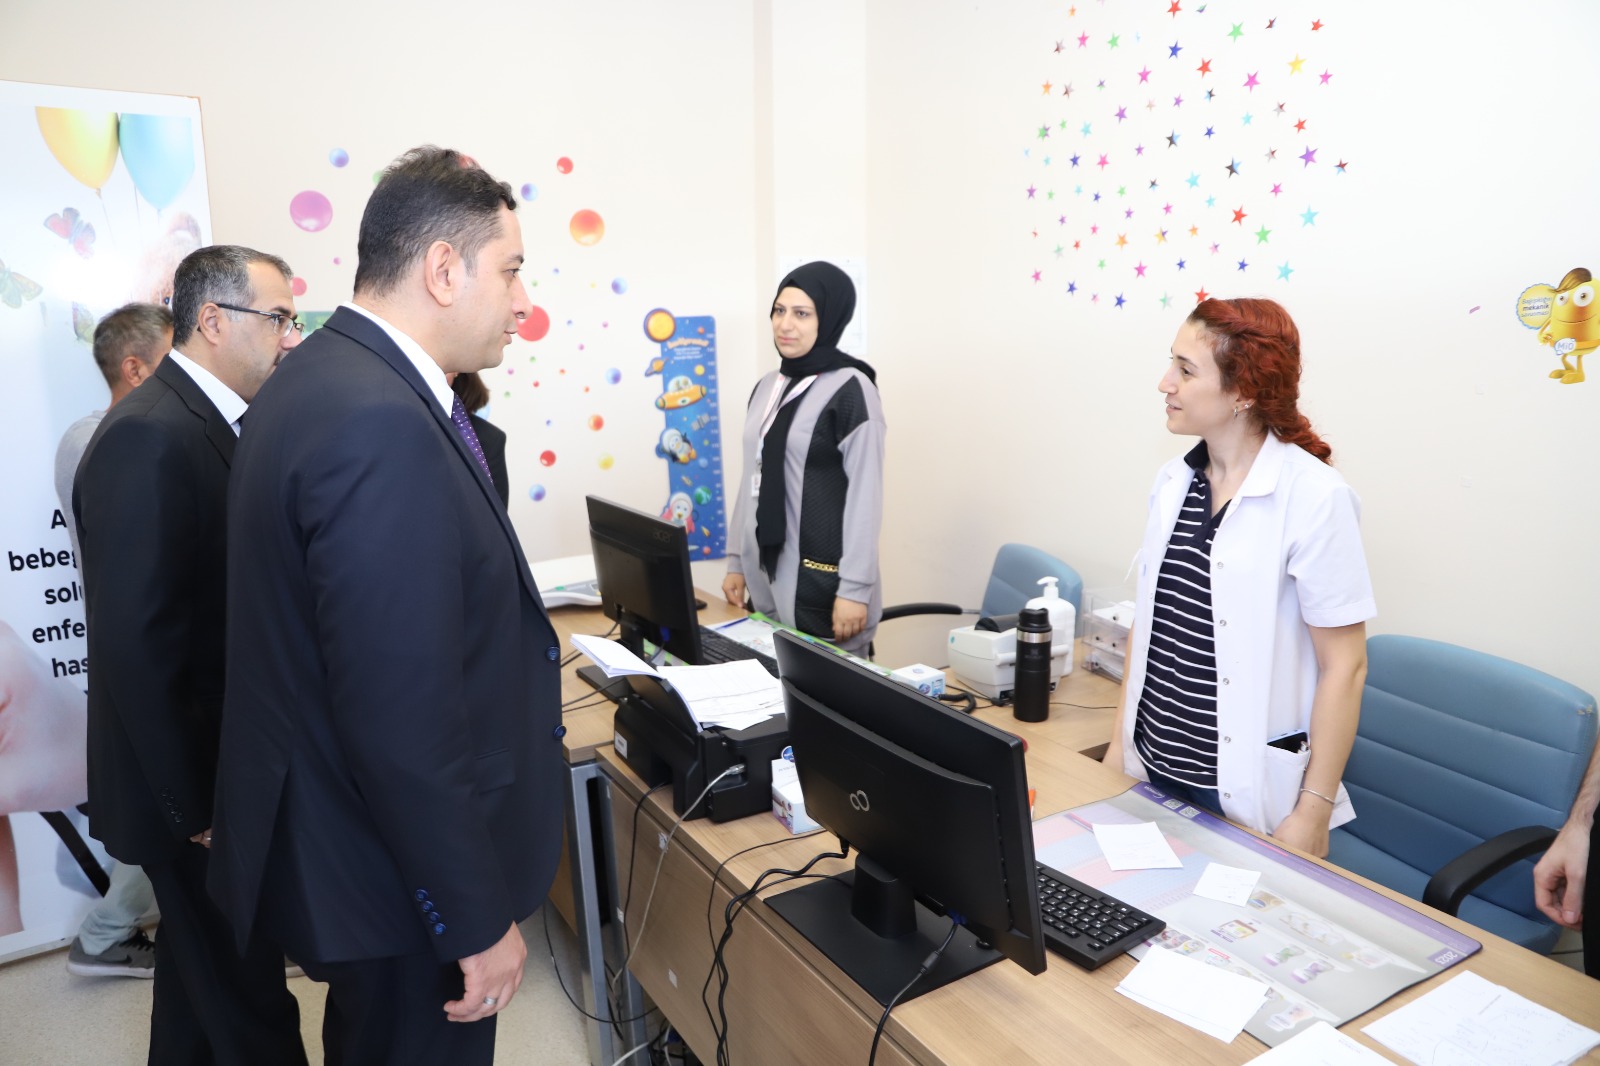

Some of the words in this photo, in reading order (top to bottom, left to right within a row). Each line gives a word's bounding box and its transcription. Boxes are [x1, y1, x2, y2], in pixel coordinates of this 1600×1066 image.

[51, 509, 67, 529] A
[8, 547, 77, 571] bebe
[32, 618, 86, 643] enfe
[1434, 950, 1458, 966] 2023
